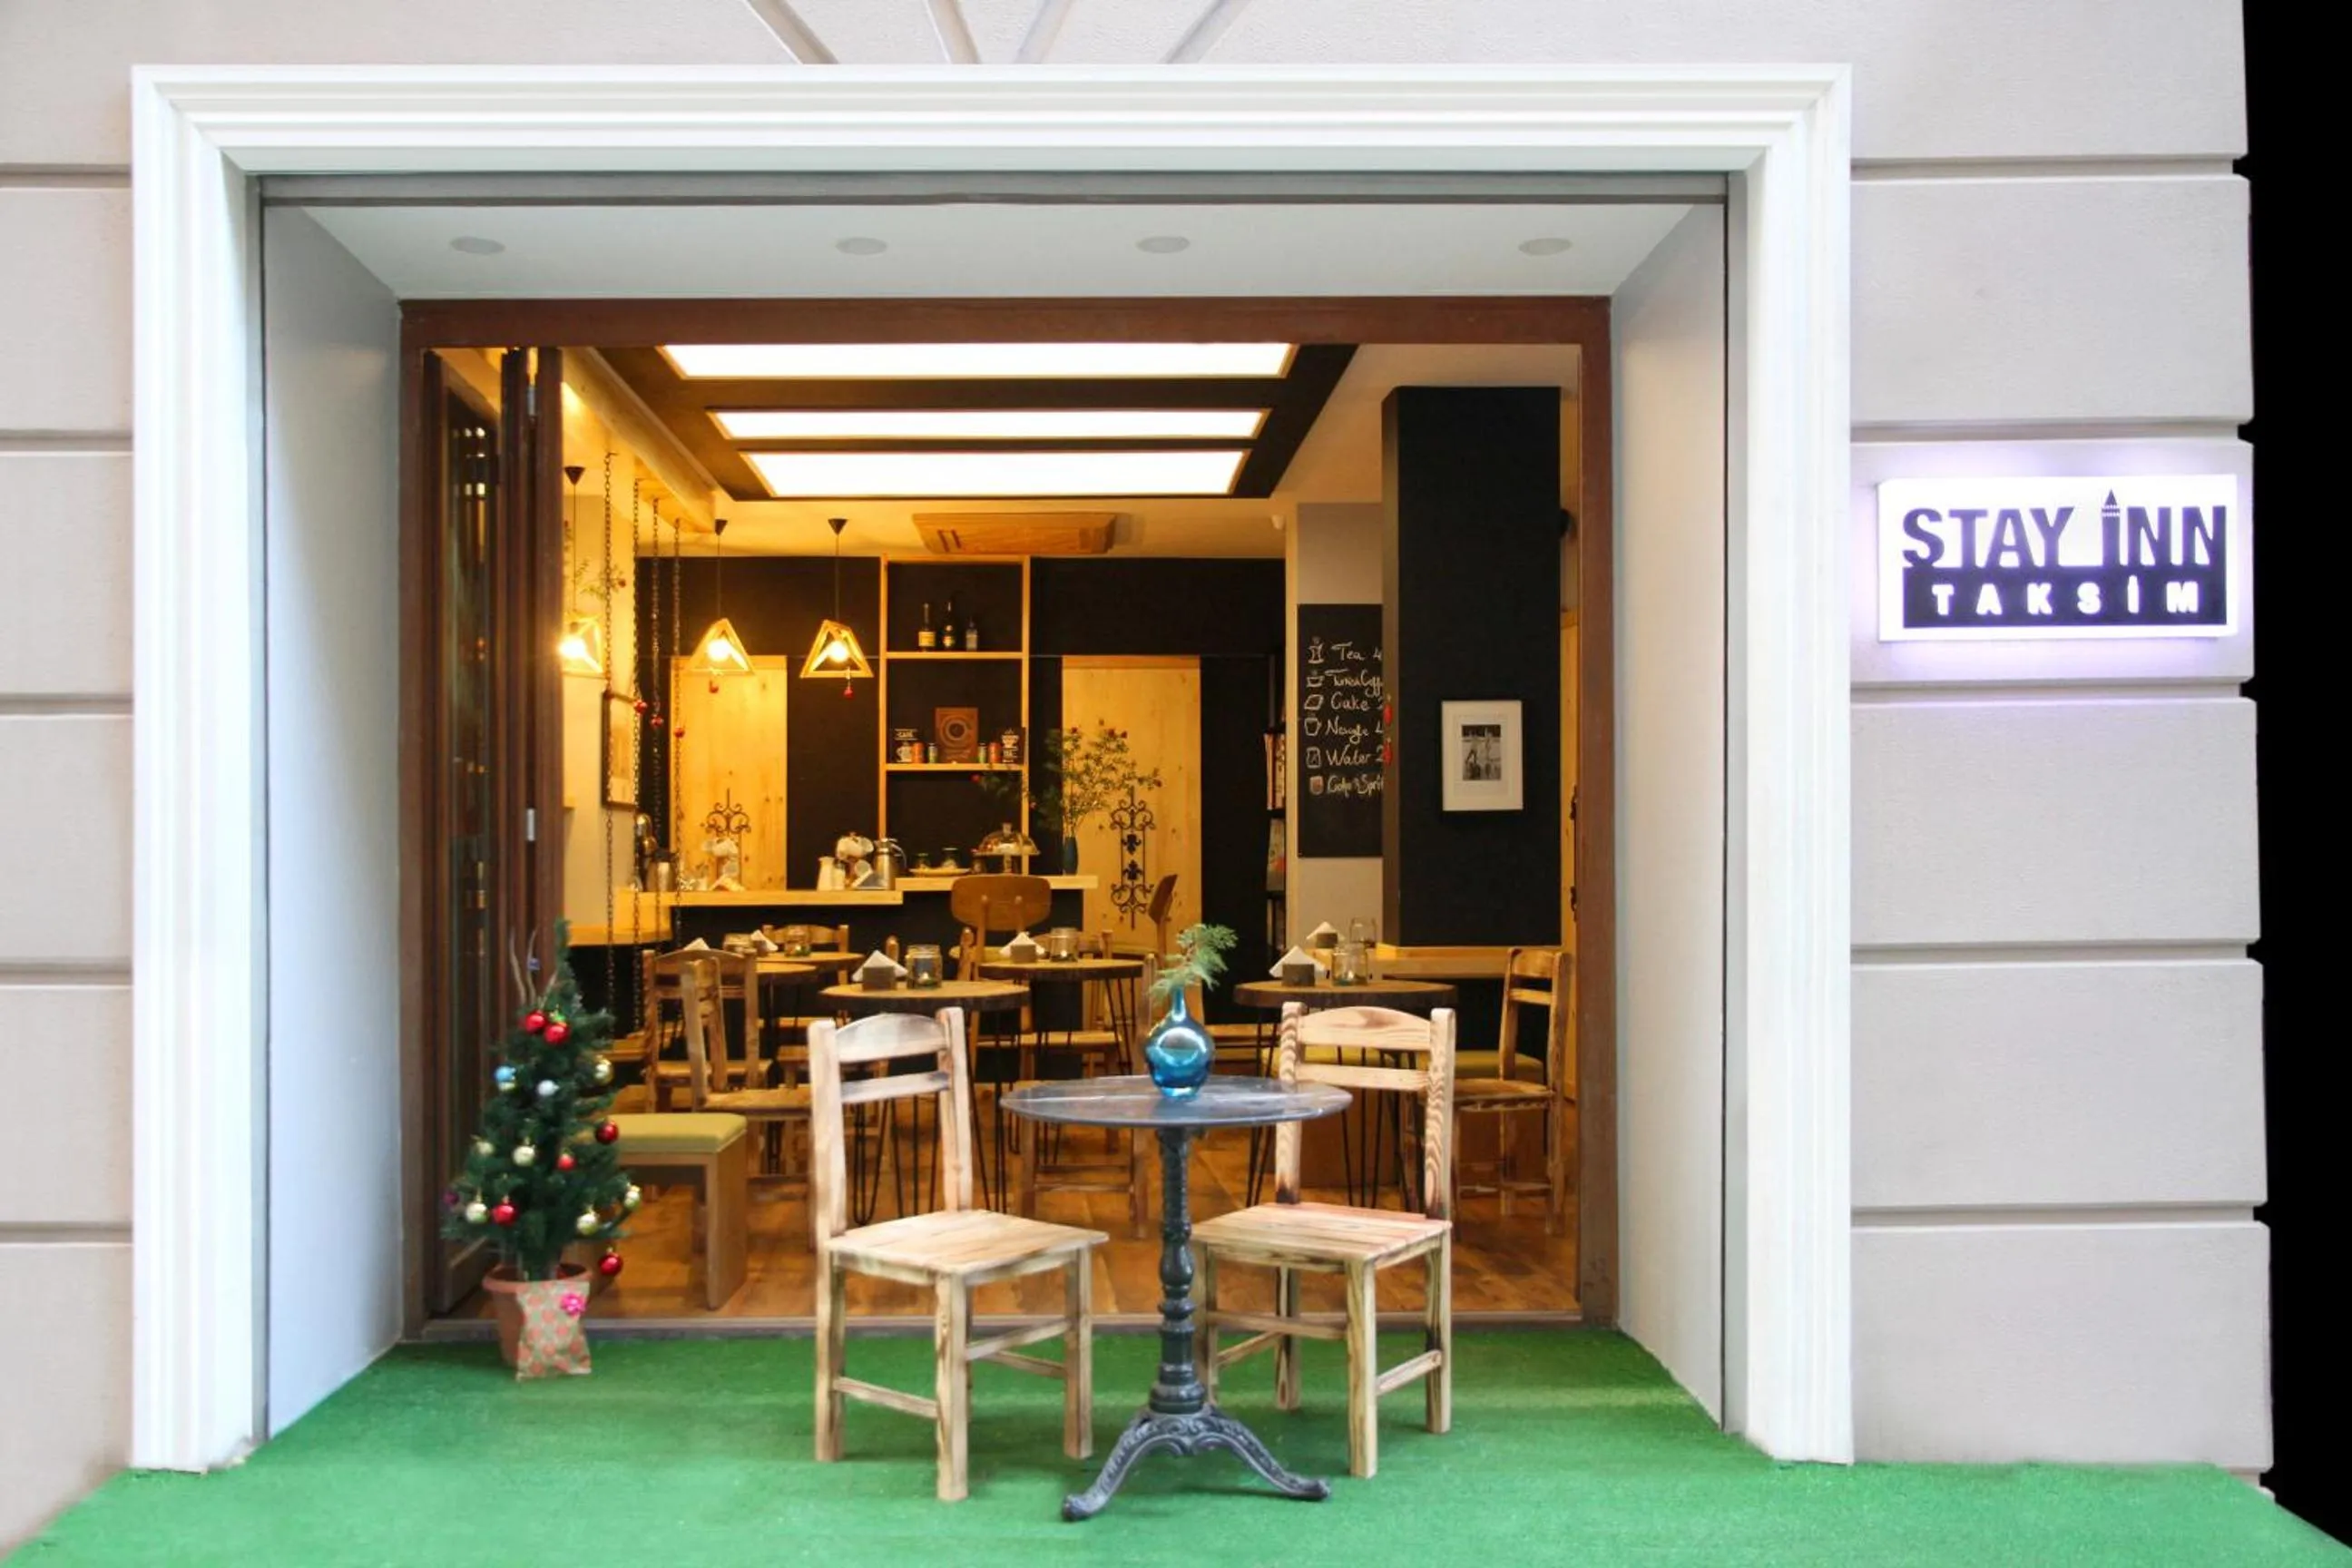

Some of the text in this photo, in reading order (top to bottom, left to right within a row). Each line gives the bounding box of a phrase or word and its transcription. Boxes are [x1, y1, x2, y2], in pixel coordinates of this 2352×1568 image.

[1902, 505, 2075, 568] STAY
[1331, 641, 1365, 662] Tea
[1330, 691, 1370, 711] Cake
[1326, 743, 1371, 766] Water
